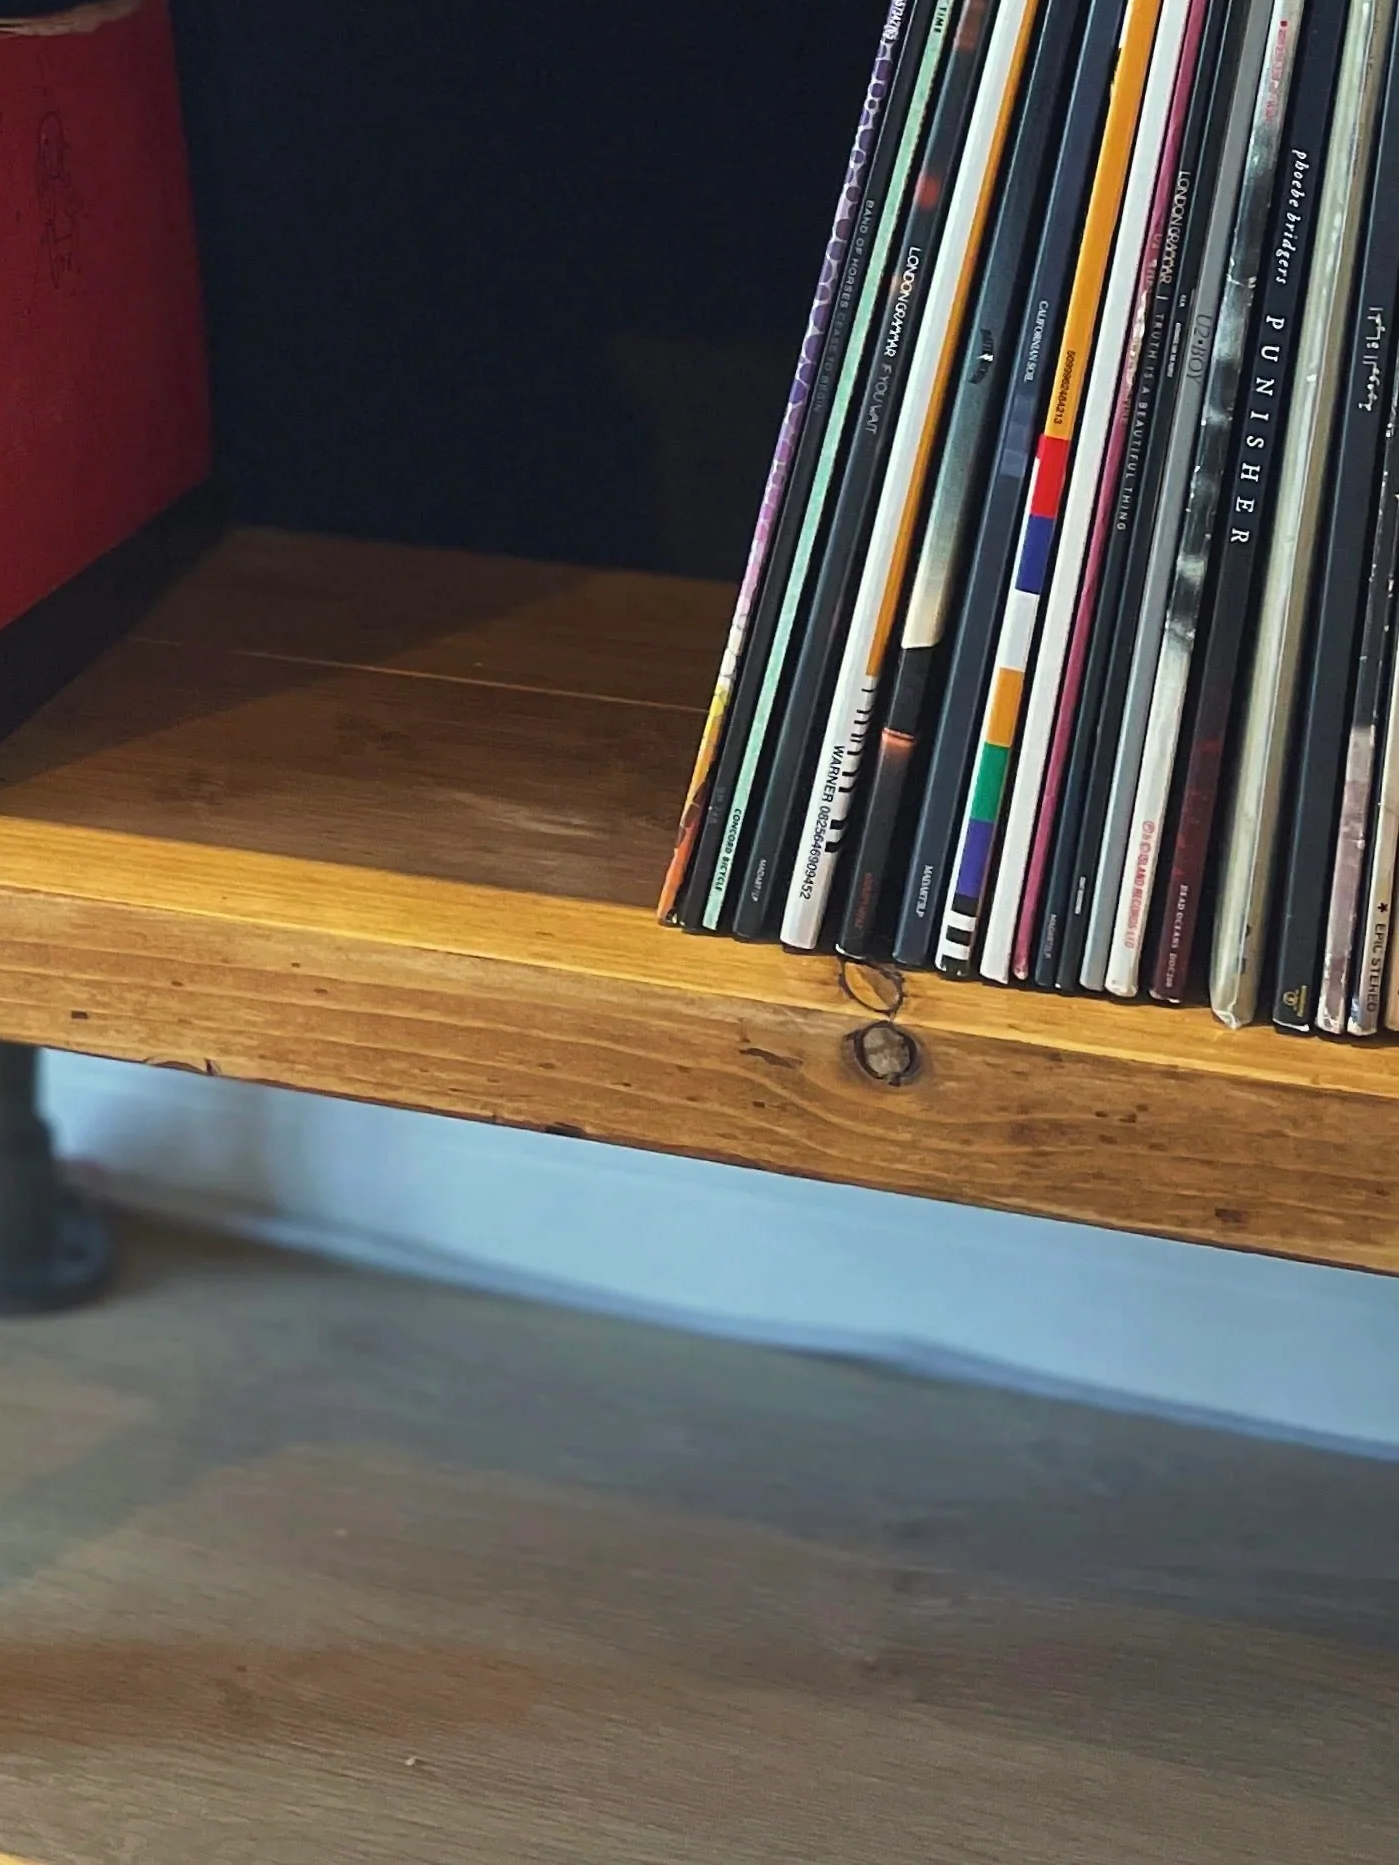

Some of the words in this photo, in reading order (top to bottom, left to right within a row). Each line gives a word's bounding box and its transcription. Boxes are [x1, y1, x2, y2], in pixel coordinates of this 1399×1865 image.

[933, 6, 948, 34] TIME
[1168, 170, 1192, 227] LONDON
[1288, 148, 1310, 208] phoebe
[859, 199, 876, 234] BAND
[854, 237, 866, 255] OF
[1158, 227, 1182, 285] GRAMMAR
[1274, 212, 1301, 285] bridgers
[839, 257, 864, 309] HORSES
[897, 246, 923, 302] LONDON
[828, 311, 846, 353] CEASE
[883, 302, 908, 358] GRAMMAR
[1028, 300, 1050, 362] CALIFORNIAN
[1147, 313, 1166, 359] TRUTH
[824, 356, 836, 371] TO
[1023, 362, 1037, 384] SOIL
[1143, 366, 1155, 379] IS
[813, 375, 831, 412] BEGIN
[872, 376, 889, 403] YOU
[1053, 349, 1077, 425] 5099962484213
[1140, 387, 1151, 395] A
[864, 403, 882, 435] WAIT
[1125, 402, 1149, 479] BEAUTIFUL
[1229, 315, 1287, 544] PUNISHER
[1116, 487, 1134, 531] THING
[822, 745, 846, 803] WARNER
[723, 808, 742, 854] CONCORD
[800, 805, 831, 900] 0825646909452
[714, 856, 731, 893] BICYCLE
[1134, 852, 1149, 887] ISLAND
[1127, 888, 1144, 929] RECORDS
[1176, 883, 1189, 911] DEAD
[1170, 912, 1184, 949] OCEANS
[1372, 922, 1388, 954] EPIC
[1366, 957, 1384, 1013] STEREO
